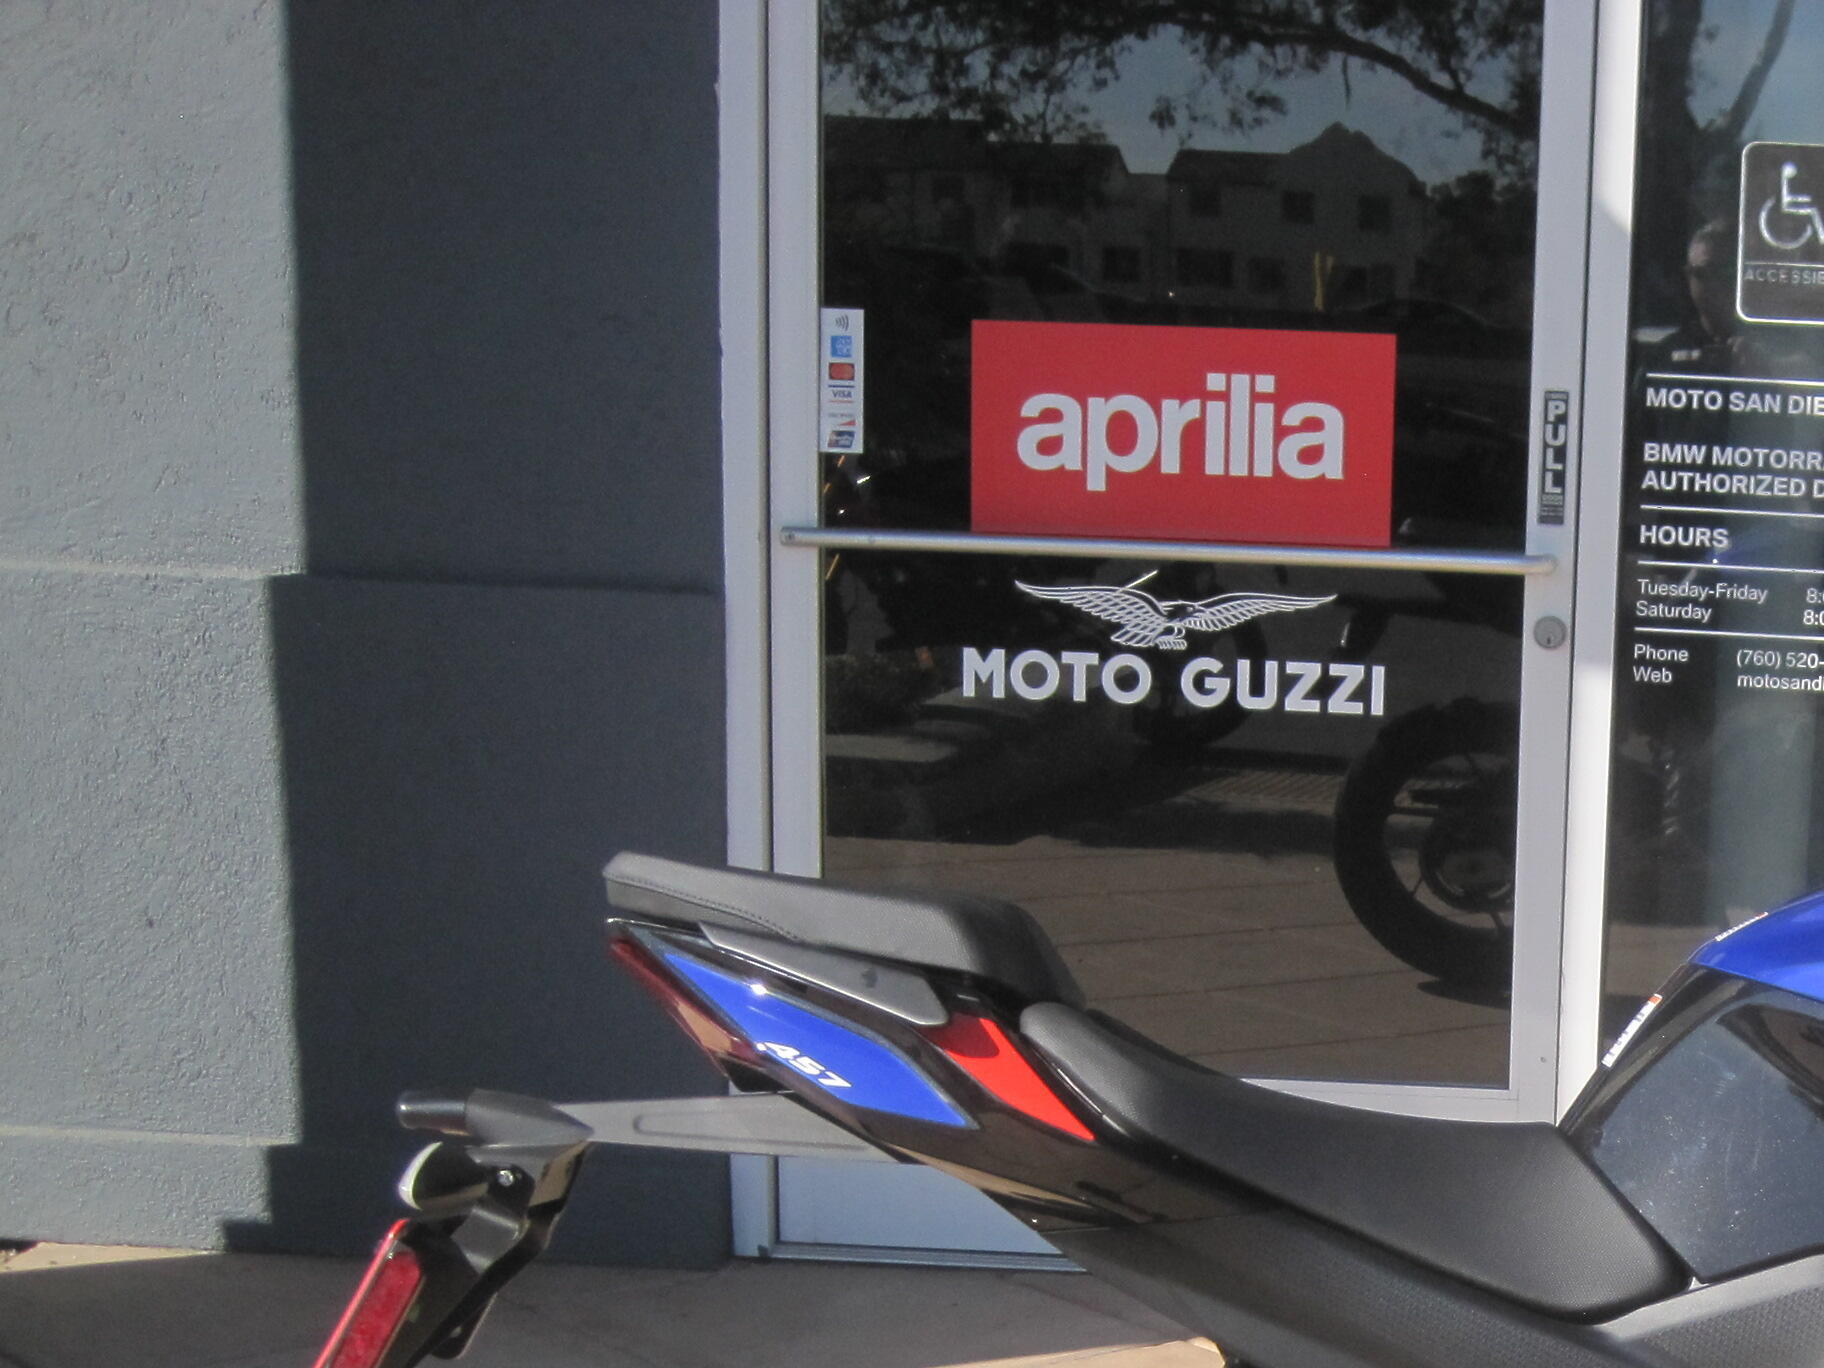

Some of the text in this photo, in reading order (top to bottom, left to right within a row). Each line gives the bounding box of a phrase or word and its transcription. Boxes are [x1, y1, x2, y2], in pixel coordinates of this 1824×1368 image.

[832, 389, 853, 398] VISA
[1646, 387, 1724, 411] MOTO
[1729, 391, 1781, 415] SAN
[1016, 372, 1345, 491] aprilia
[1544, 401, 1566, 494] PULL
[1643, 442, 1706, 465] BMW
[1641, 470, 1806, 498] AUTHORIZED
[1640, 525, 1729, 548] HOURS
[1637, 578, 1768, 604] Tuesday-Friday
[1635, 601, 1712, 622] Saturday
[1633, 644, 1689, 663] Phone
[1736, 650, 1781, 669] (760)
[961, 647, 1386, 716] MOTO GUZZI
[1633, 666, 1672, 684] Web
[760, 1041, 852, 1088] 457
